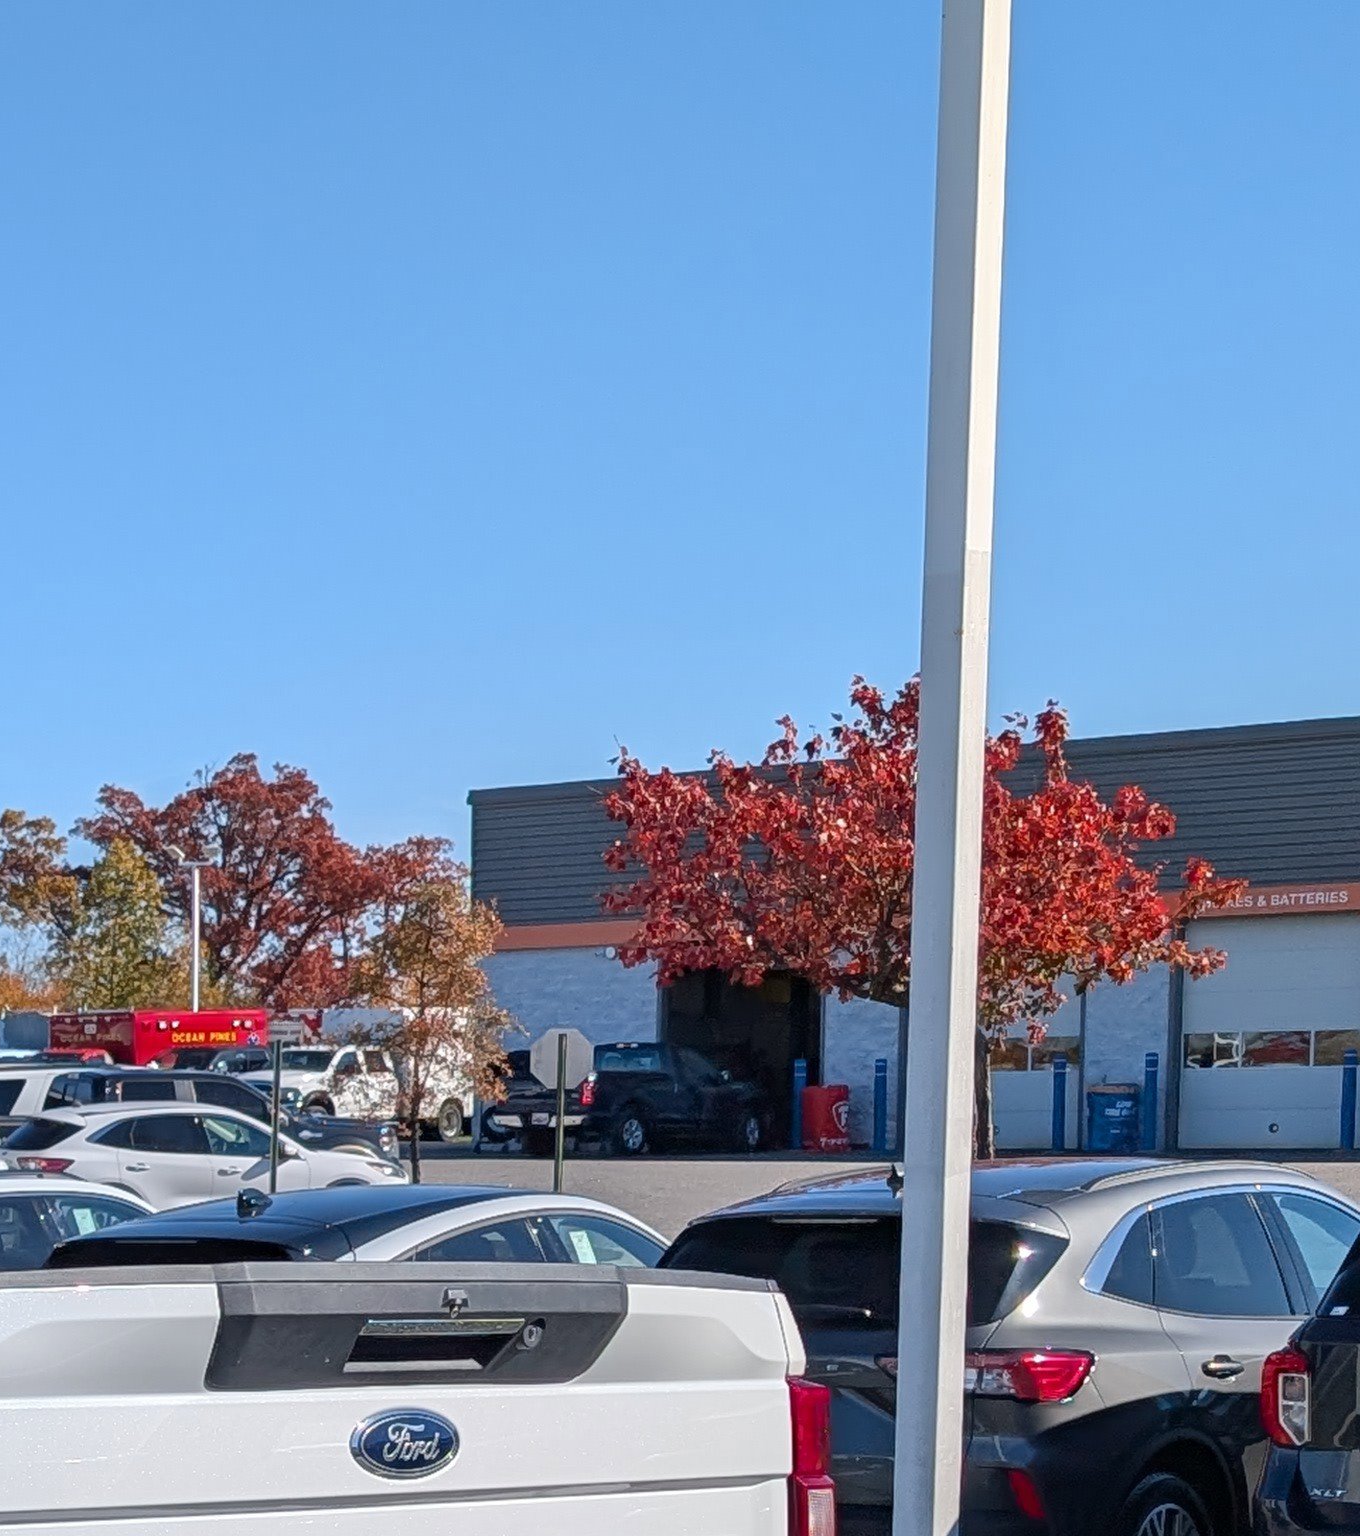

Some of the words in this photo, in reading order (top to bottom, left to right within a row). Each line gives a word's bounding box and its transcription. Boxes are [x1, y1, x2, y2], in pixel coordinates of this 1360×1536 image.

[1257, 894, 1267, 907] &
[1270, 890, 1348, 906] BATTERIES
[172, 1032, 205, 1042] OCEAN
[383, 1423, 440, 1462] Ford
